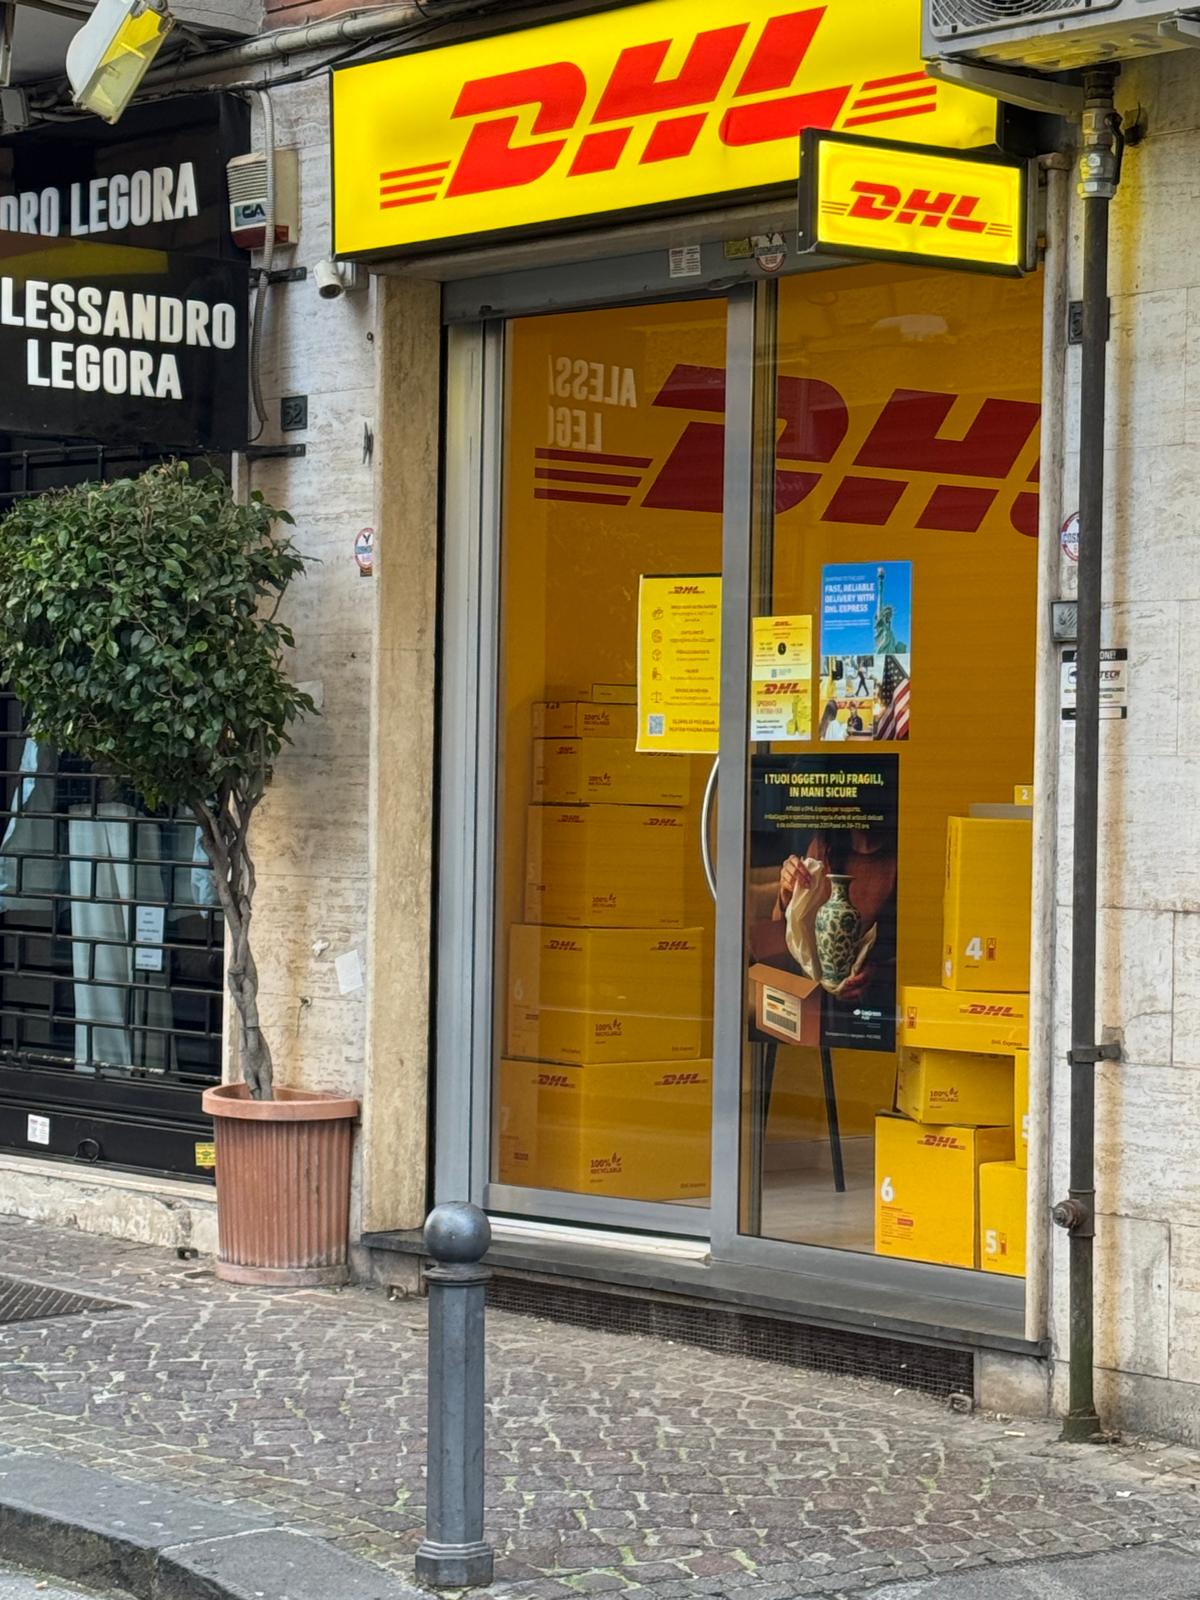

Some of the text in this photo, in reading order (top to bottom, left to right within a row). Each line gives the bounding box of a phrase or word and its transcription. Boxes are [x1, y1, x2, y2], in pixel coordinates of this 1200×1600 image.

[444, 5, 852, 199] DHL
[70, 161, 198, 237] LEGORA
[847, 180, 988, 234] DHL
[1, 276, 236, 350] LESSANDRO
[27, 338, 183, 400] LEGORA
[764, 770, 884, 786] I TUOI OGGETTI PIÙ FRAGILI,
[789, 787, 858, 797] IN MANI SICURE
[1021, 788, 1029, 800] 2
[965, 937, 983, 960] 4
[967, 1004, 1014, 1017] DHL
[923, 1134, 960, 1149] DHL
[591, 1159, 611, 1168] 100%
[881, 1176, 895, 1202] 6
[985, 1229, 998, 1254] 5
